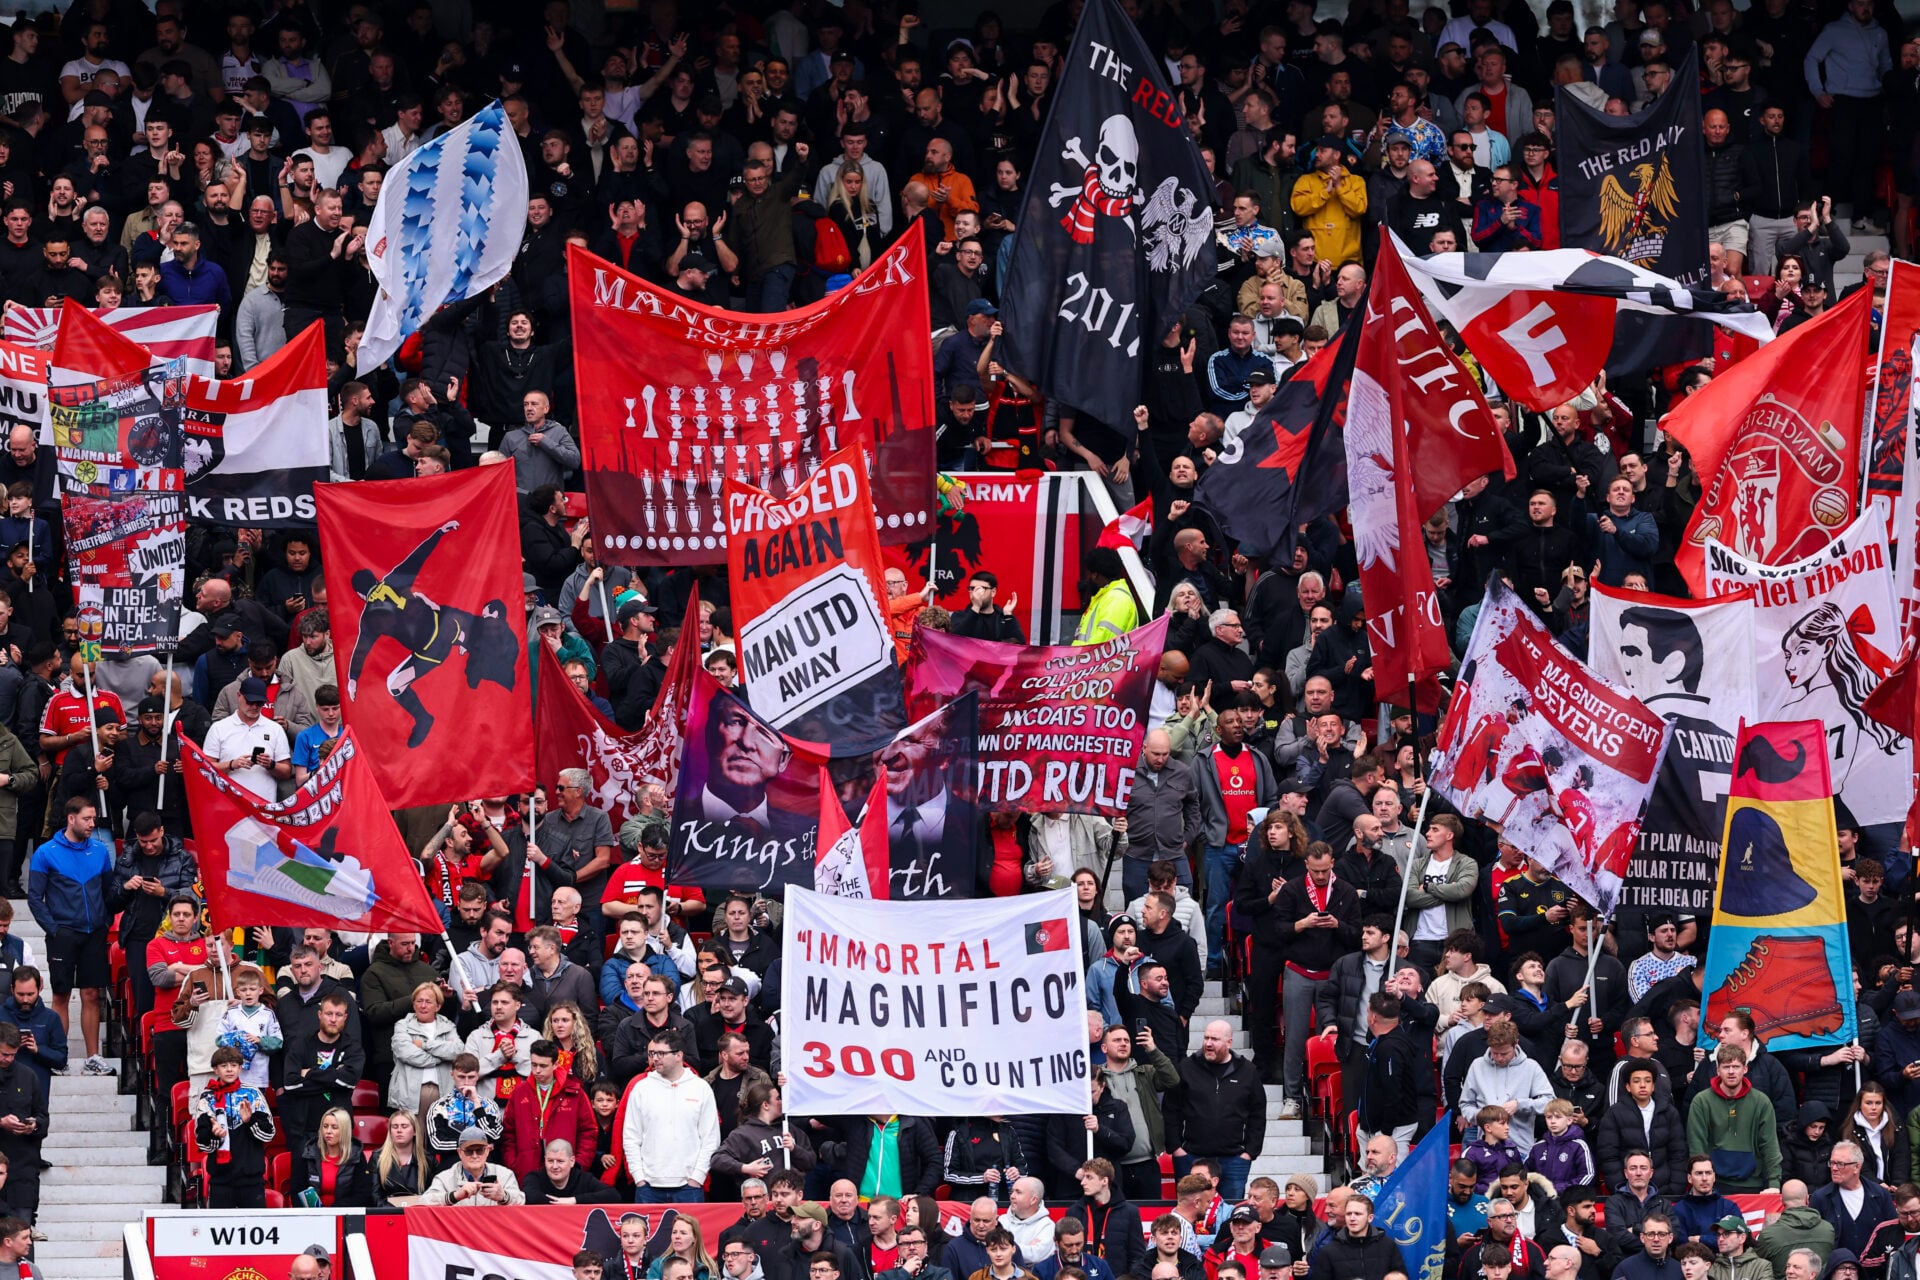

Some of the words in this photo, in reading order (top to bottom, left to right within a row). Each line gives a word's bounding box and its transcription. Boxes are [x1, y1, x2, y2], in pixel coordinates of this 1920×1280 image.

[1088, 40, 1133, 92] THE
[1131, 76, 1182, 129] RED
[1578, 152, 1614, 180] THE
[1617, 138, 1651, 165] RED
[1655, 125, 1685, 152] AY
[54, 386, 94, 406] TED
[187, 410, 211, 423] RA
[187, 424, 217, 434] HESTER
[62, 447, 106, 461] WANNA
[107, 451, 122, 463] BE
[964, 484, 1033, 503] ARMY
[223, 494, 317, 521] REDS
[73, 531, 113, 551] STRETFORD
[122, 517, 151, 537] ENDERS
[742, 517, 845, 582] AGAIN
[82, 565, 92, 574] NO
[93, 564, 109, 574] ONE
[934, 569, 954, 581] TRA
[112, 588, 146, 606] 0161
[1712, 576, 1799, 608] scarlet
[104, 606, 119, 623] IN
[743, 627, 798, 683] MAN
[794, 592, 859, 648] UTD
[780, 646, 842, 703] AWAY
[1534, 677, 1624, 757] SEVENS
[1541, 659, 1660, 753] MAGNIFICENT
[69, 716, 92, 724] SHA
[1093, 705, 1137, 731] TOO
[978, 735, 1000, 751] WN
[1003, 735, 1023, 751] OF
[1026, 735, 1132, 758] MANCHESTER
[1825, 724, 1846, 761] 7
[802, 825, 817, 842] of
[1650, 832, 1682, 853] PLAY
[679, 820, 796, 876] Kings
[801, 843, 817, 861] th
[888, 852, 951, 898] rth
[1626, 859, 1667, 880] CULAR
[1671, 860, 1711, 884] TEAM,
[840, 877, 861, 893] THE
[1632, 886, 1657, 905] THE
[1658, 887, 1689, 908] IDEA
[1692, 889, 1710, 908] OF
[802, 1041, 916, 1082] 300
[924, 1048, 966, 1063] AND
[940, 1049, 1087, 1088] COUNTING
[210, 1226, 280, 1245] W104
